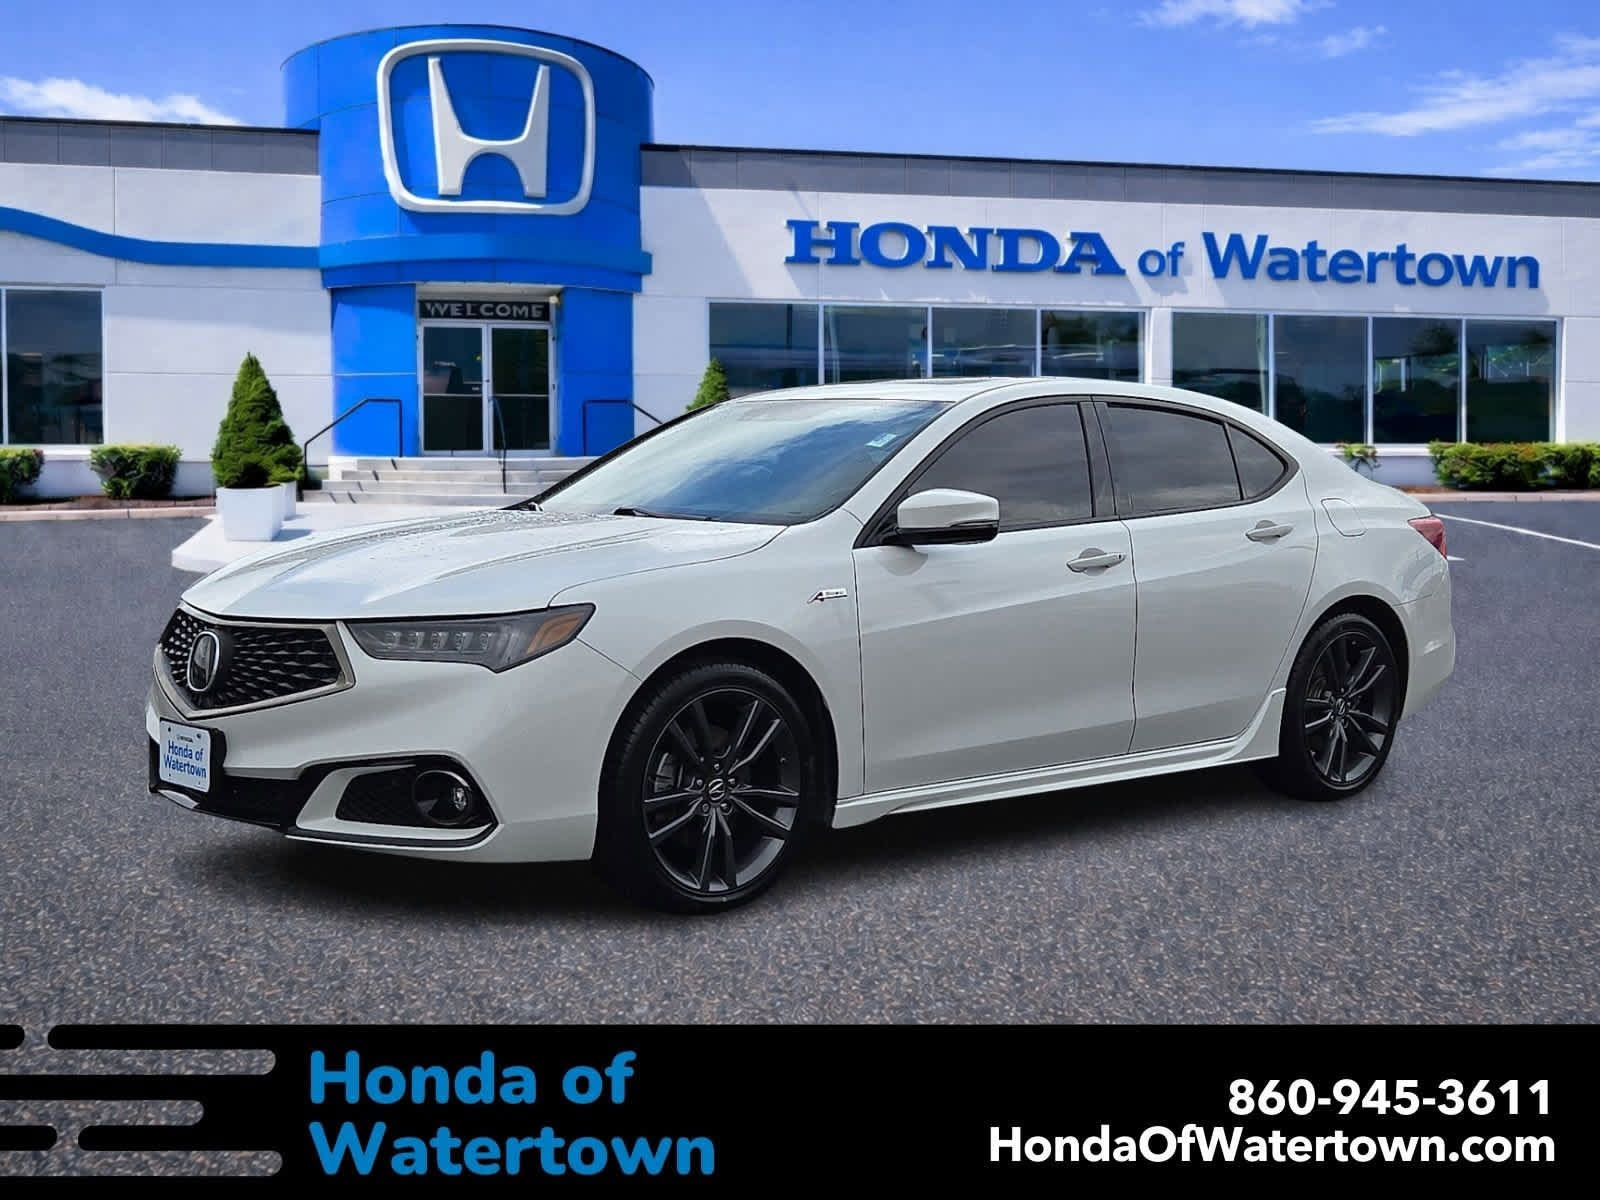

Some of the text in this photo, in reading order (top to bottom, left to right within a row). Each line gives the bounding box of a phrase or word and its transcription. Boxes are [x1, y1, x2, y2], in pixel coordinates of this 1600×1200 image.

[784, 218, 1541, 289] HONDA of Watertown
[425, 302, 544, 319] WELCOME
[168, 740, 204, 762] Honda of
[164, 754, 207, 779] Watertown
